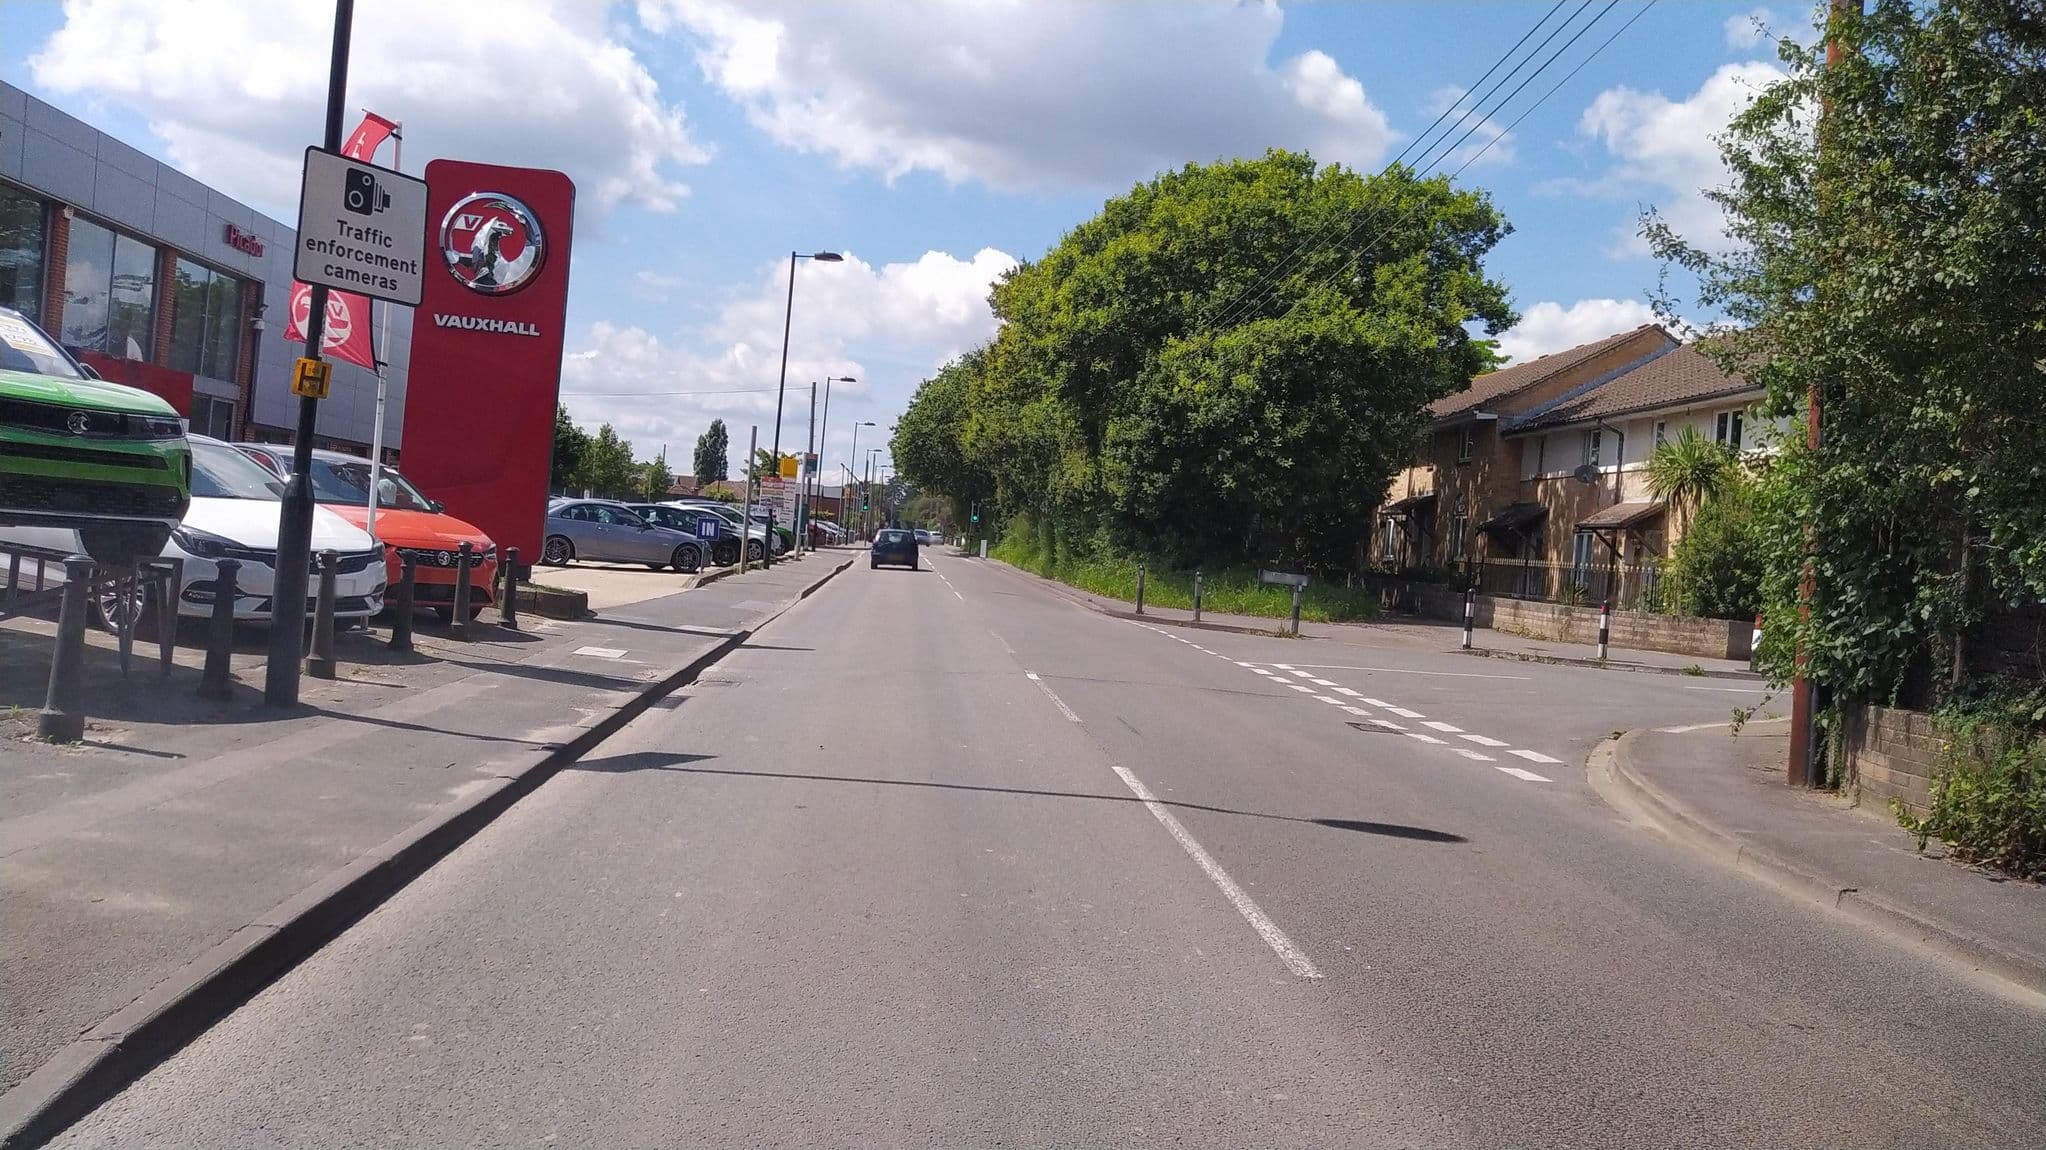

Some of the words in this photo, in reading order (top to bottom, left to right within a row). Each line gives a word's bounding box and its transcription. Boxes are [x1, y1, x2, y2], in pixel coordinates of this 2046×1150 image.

[337, 219, 393, 248] Traffic
[306, 238, 418, 275] enforcement
[324, 264, 398, 291] cameras
[433, 313, 541, 337] VAUXHALL
[297, 362, 328, 395] H
[701, 521, 715, 537] IN
